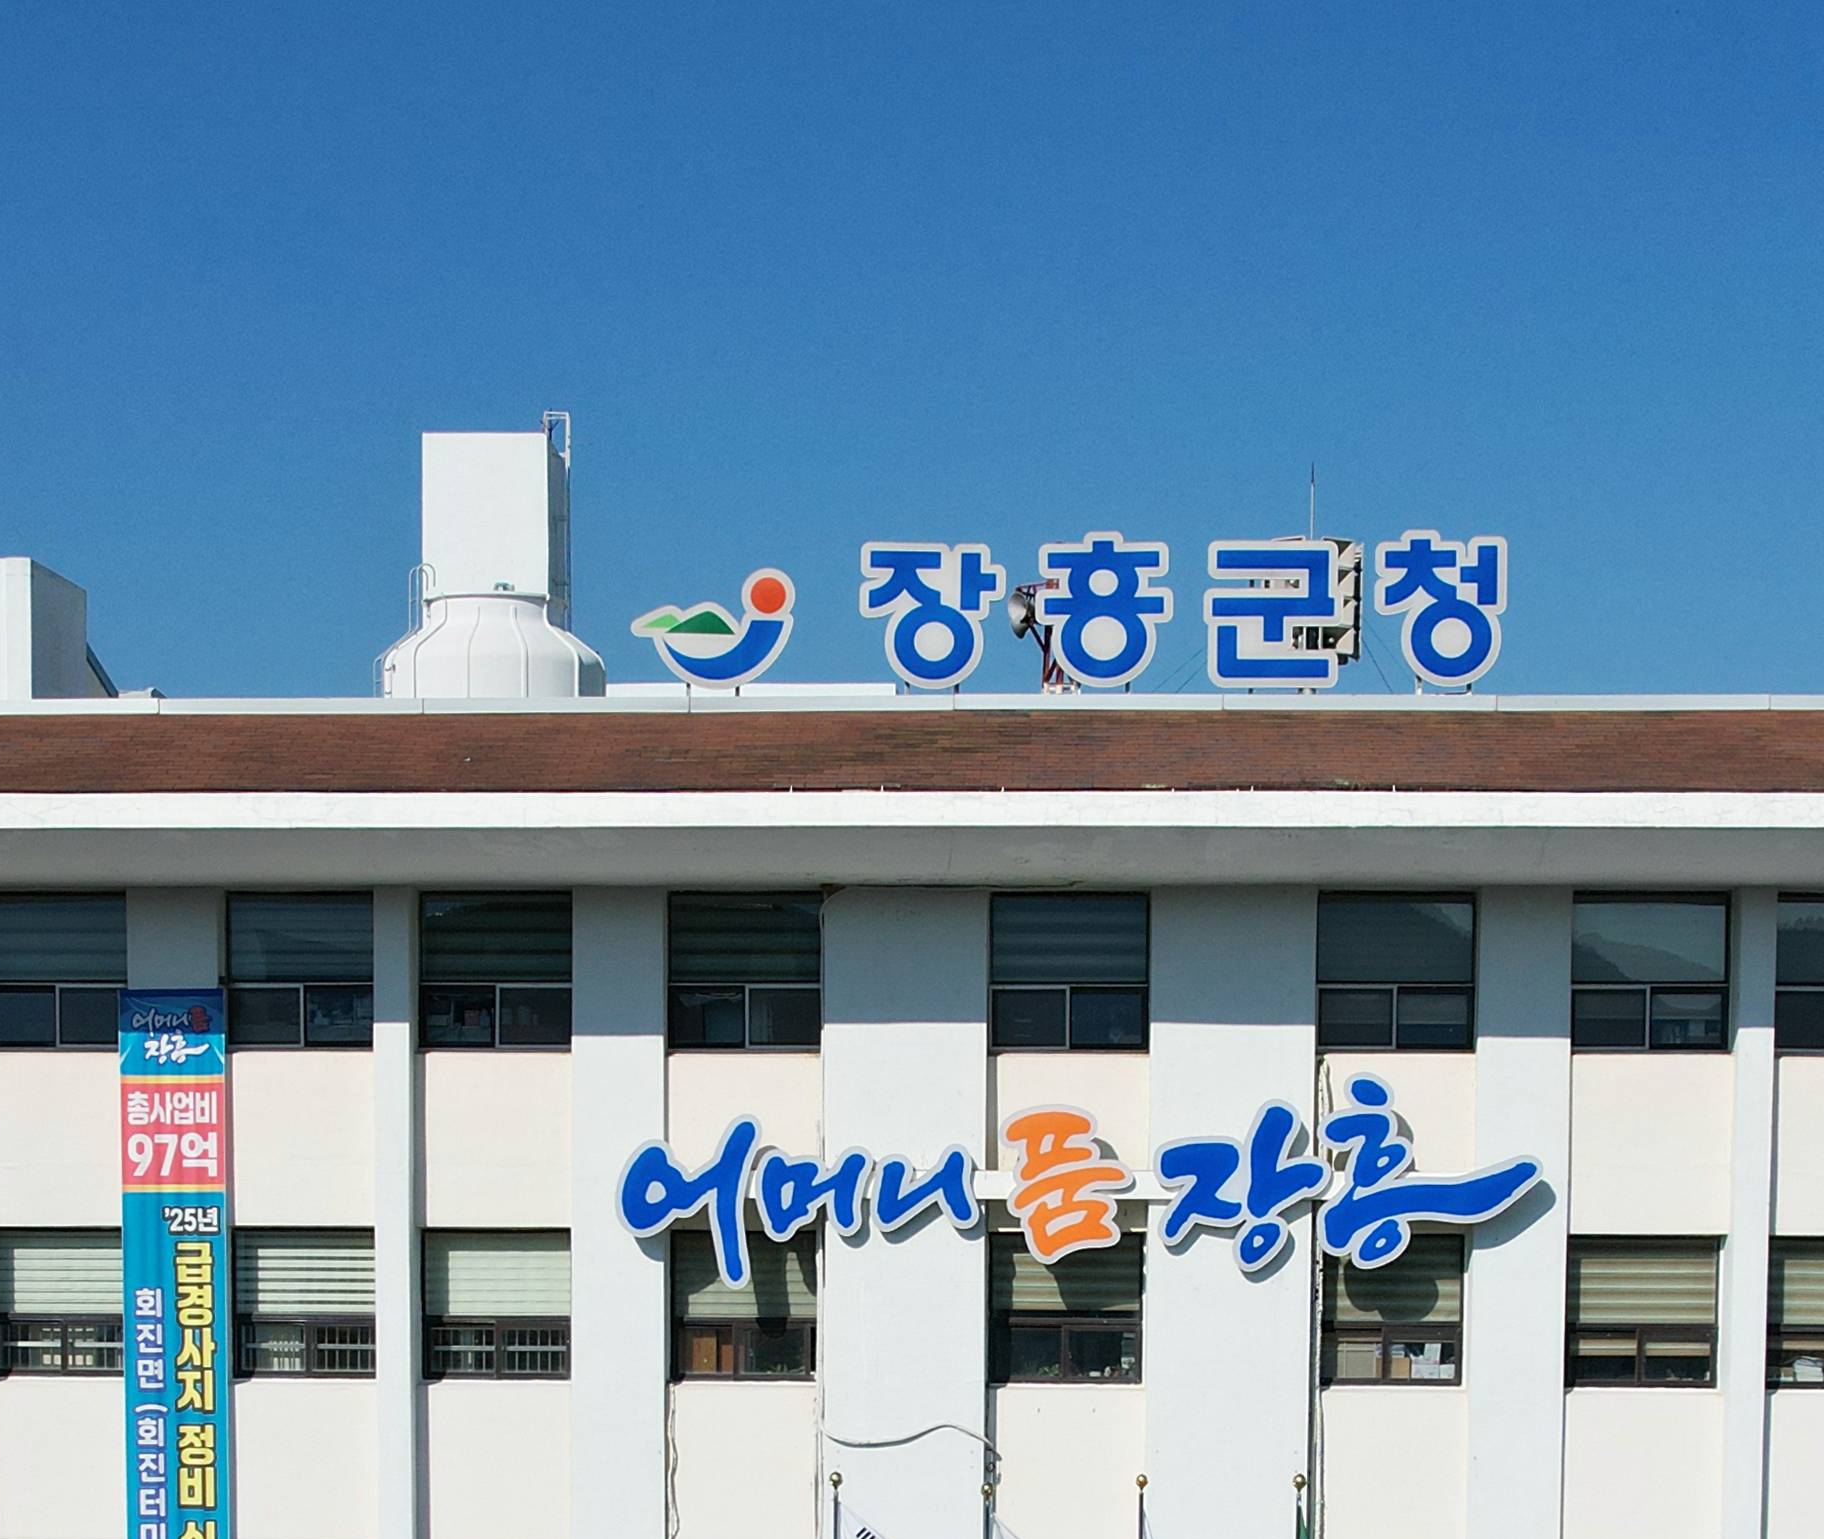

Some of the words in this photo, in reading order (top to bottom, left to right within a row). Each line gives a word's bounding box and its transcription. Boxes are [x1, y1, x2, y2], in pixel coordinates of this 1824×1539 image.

[860, 532, 1508, 688] 장흥군청
[126, 1090, 218, 1127] 총사업비
[126, 1131, 219, 1179] 97억
[616, 1113, 977, 1288] 어머니
[1001, 1104, 1133, 1265] 품
[1154, 1073, 1544, 1272] 장흥
[134, 1286, 167, 1393] 회진면
[174, 1240, 217, 1414] 급경사지
[176, 1422, 218, 1511] 정비
